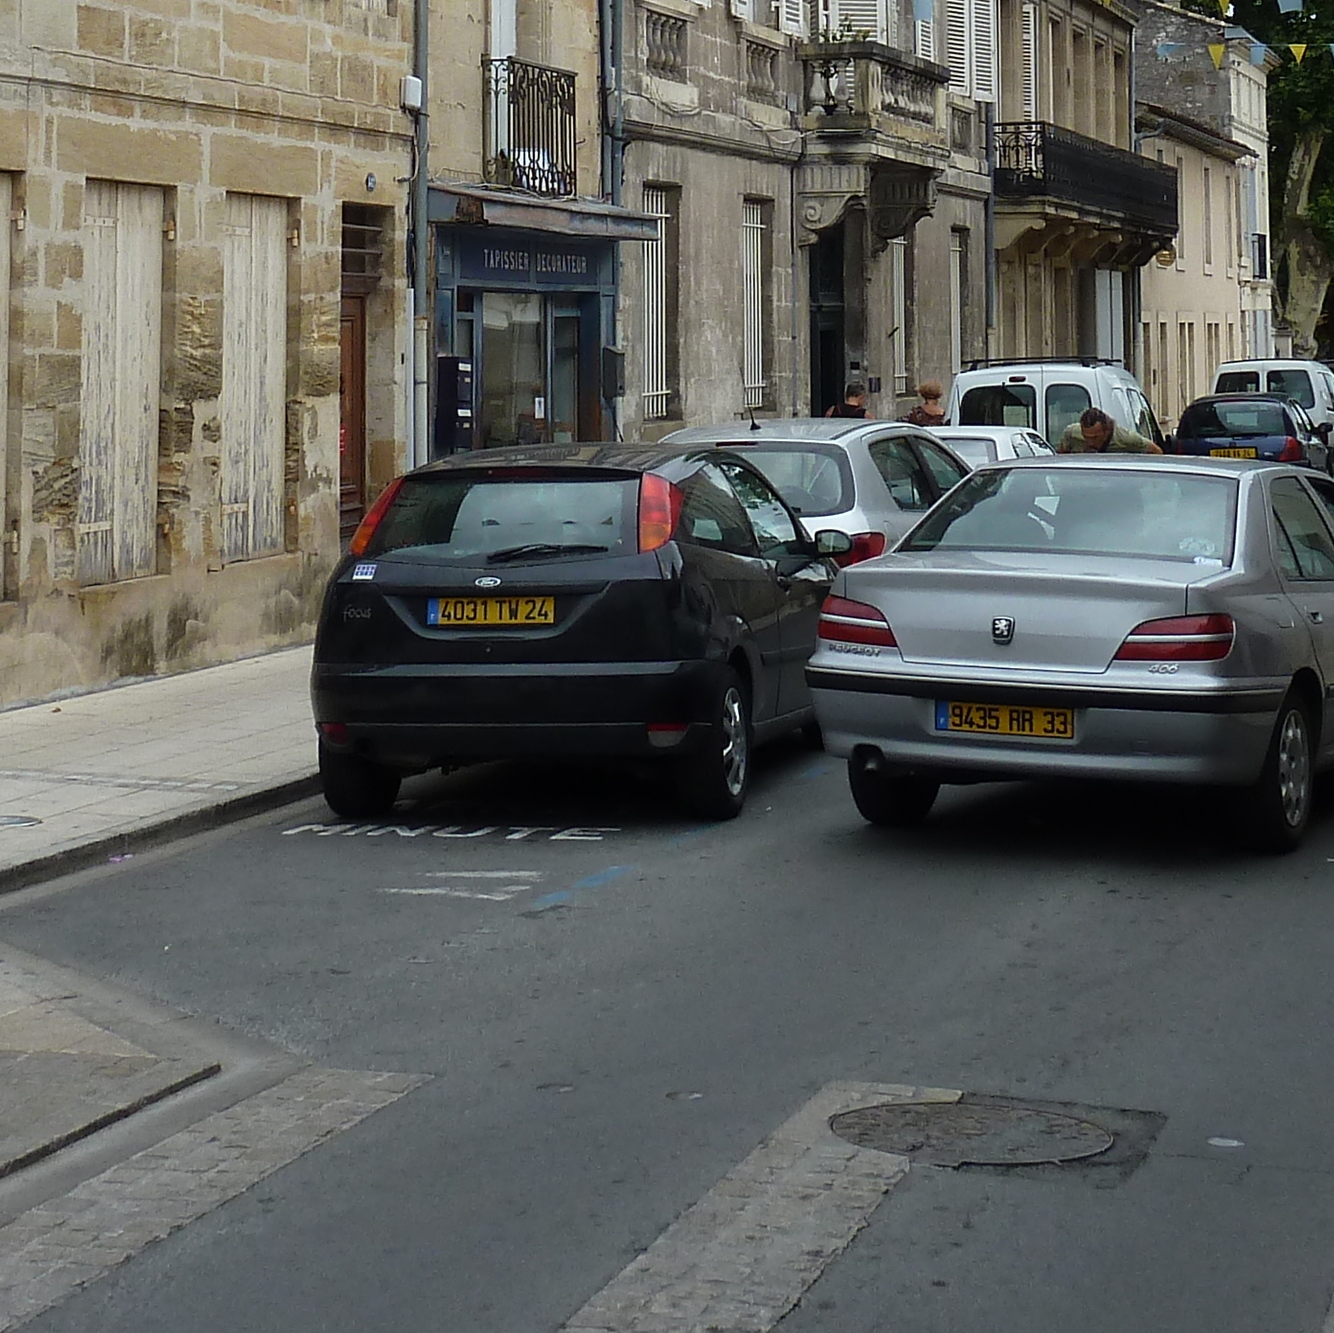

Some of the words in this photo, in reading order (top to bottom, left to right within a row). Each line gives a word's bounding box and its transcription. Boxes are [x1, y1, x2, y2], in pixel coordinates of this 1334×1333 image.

[484, 249, 529, 270] TAPISSIER
[536, 253, 587, 274] DECORATEUR
[441, 599, 488, 621] 4031
[495, 599, 519, 621] TW
[524, 599, 549, 621] 24
[828, 644, 882, 658] PEUGEOT
[1148, 663, 1180, 674] 406
[951, 705, 1000, 730] 9435
[1042, 711, 1068, 734] 33
[281, 823, 622, 841] MINUTE
